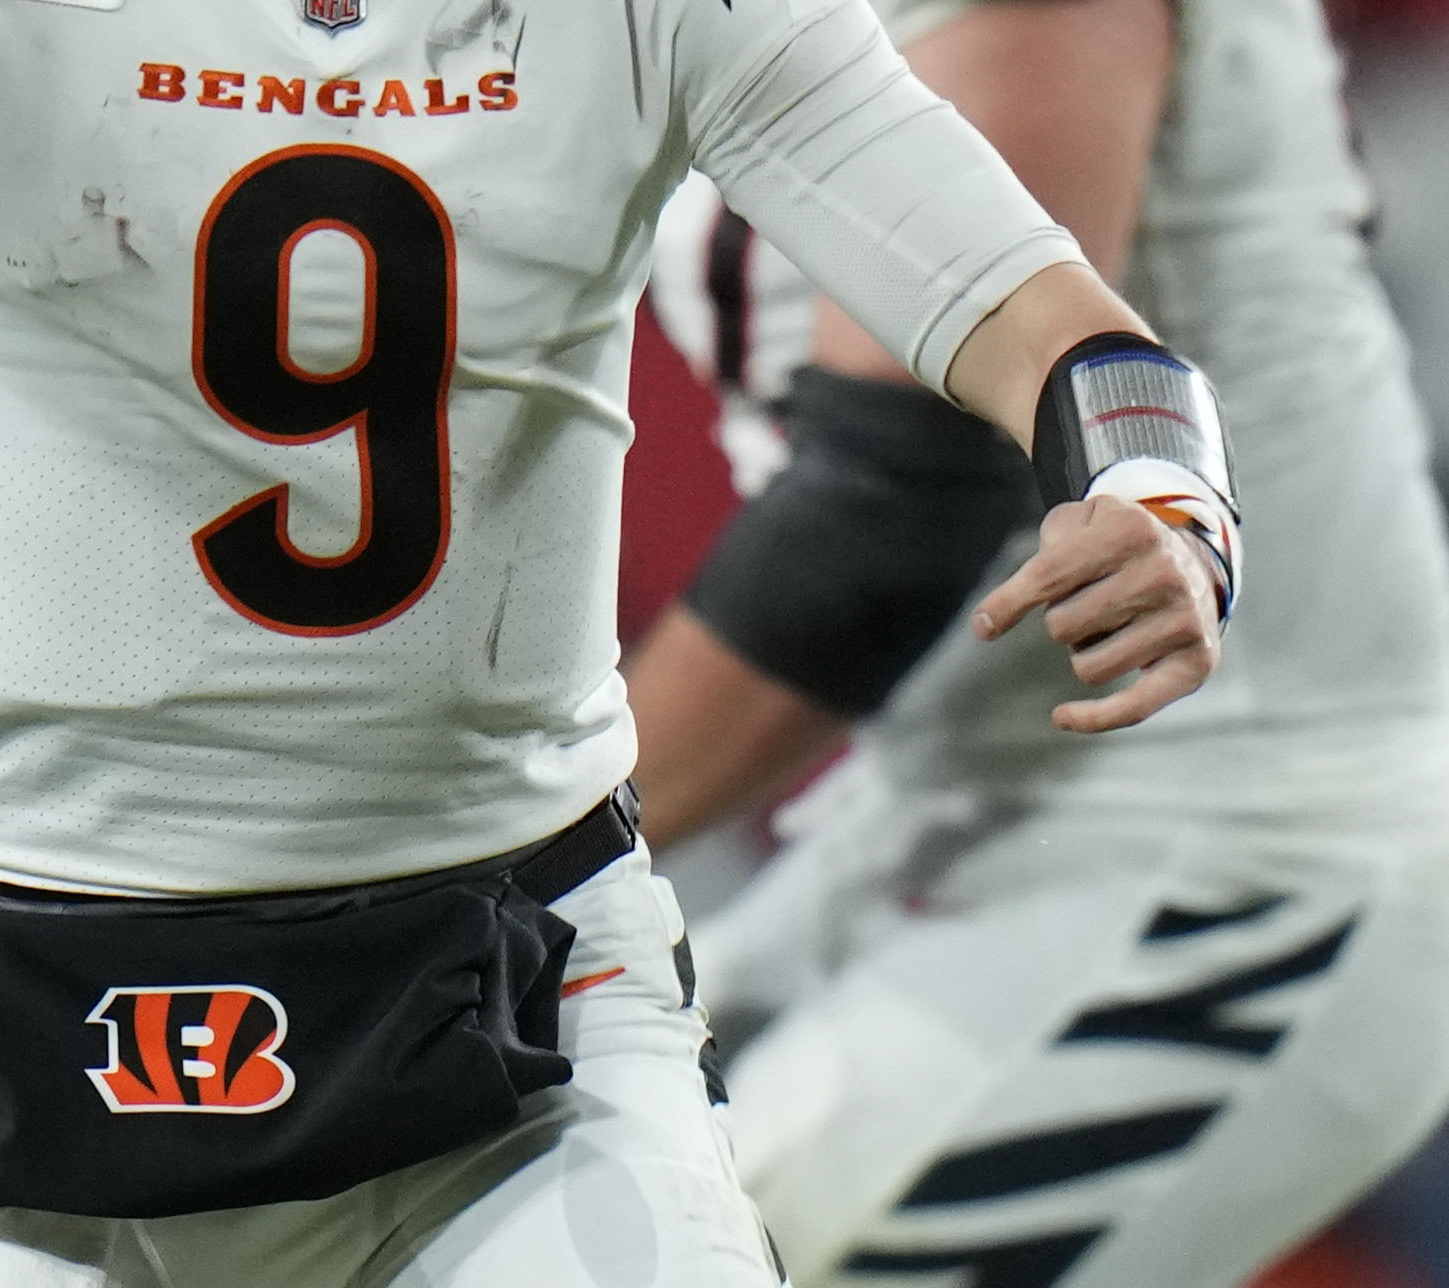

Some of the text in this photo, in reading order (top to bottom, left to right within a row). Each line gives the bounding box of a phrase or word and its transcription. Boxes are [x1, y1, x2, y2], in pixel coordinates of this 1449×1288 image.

[137, 62, 519, 118] BENGALS
[191, 142, 456, 636] 9
[84, 984, 297, 1114] B
